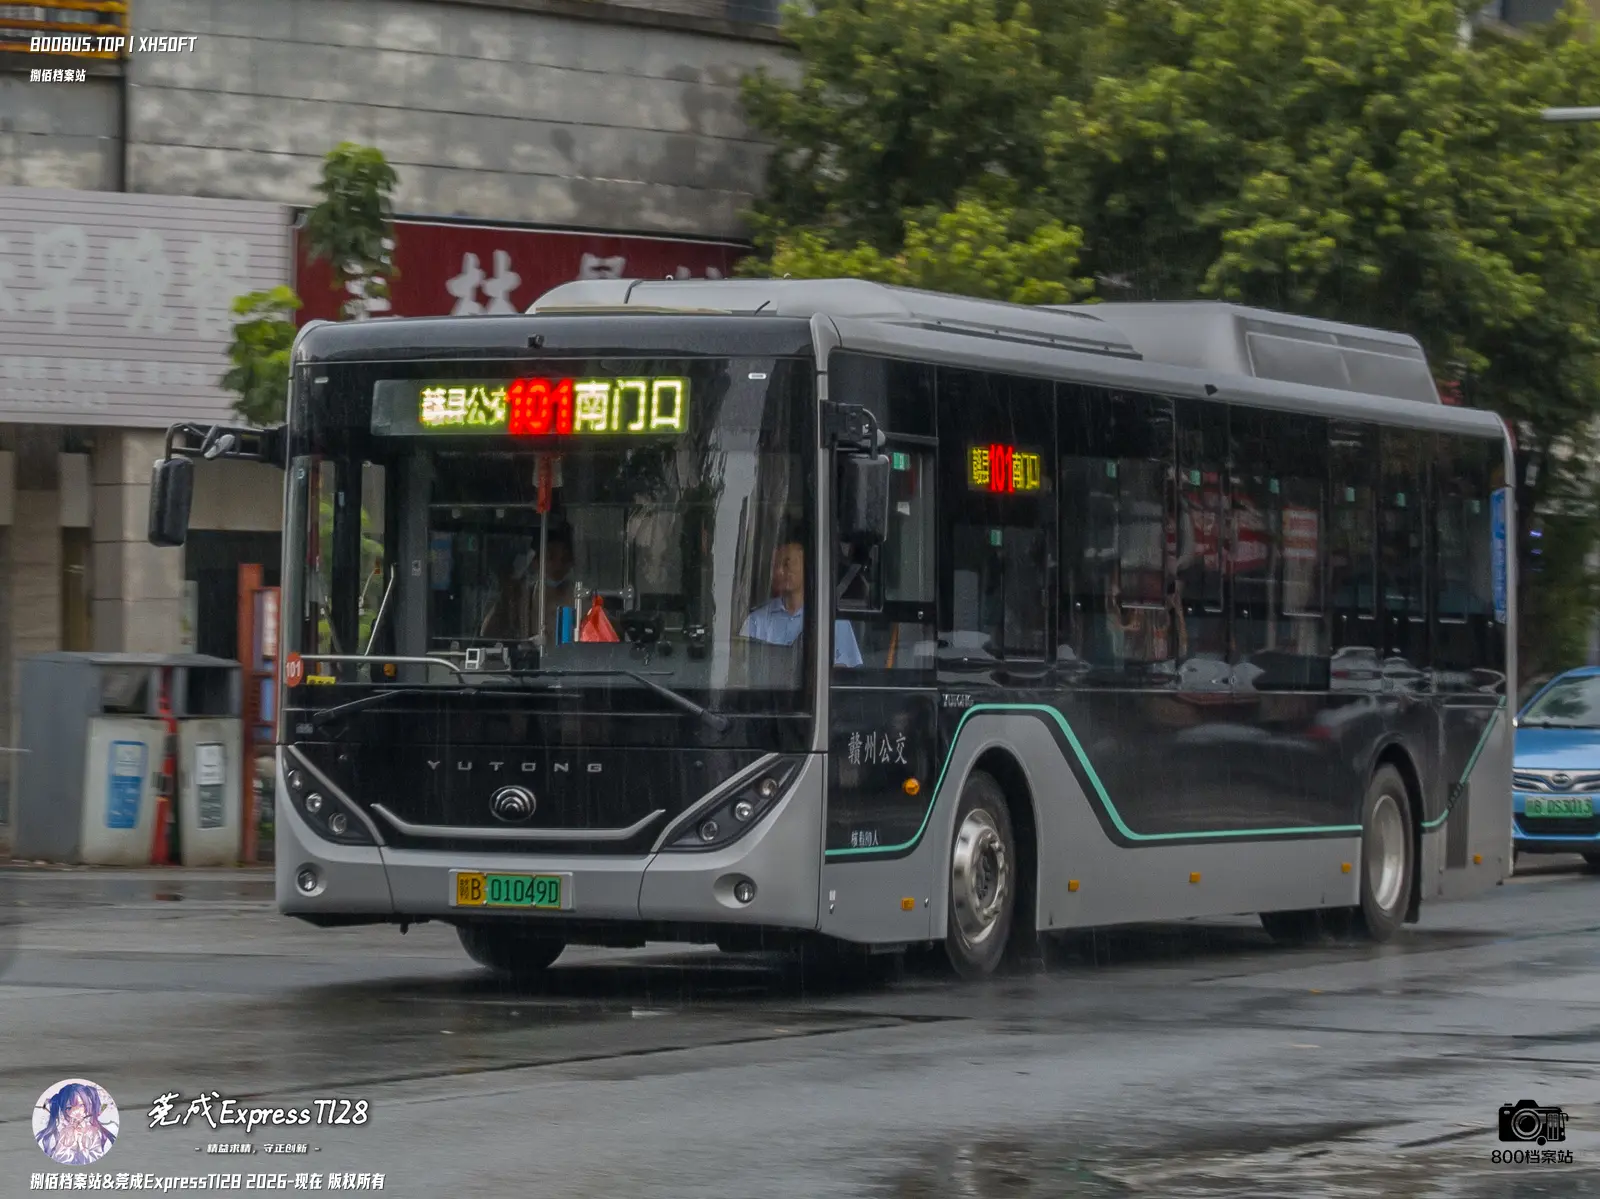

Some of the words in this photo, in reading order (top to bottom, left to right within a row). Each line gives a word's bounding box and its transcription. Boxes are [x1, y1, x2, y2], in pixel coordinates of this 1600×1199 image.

[506, 377, 573, 434] 101
[573, 378, 683, 431] 南门口
[989, 443, 1014, 493] 101
[285, 660, 302, 678] 101
[427, 759, 603, 773] YUTONG
[848, 731, 908, 766] 赣州公交
